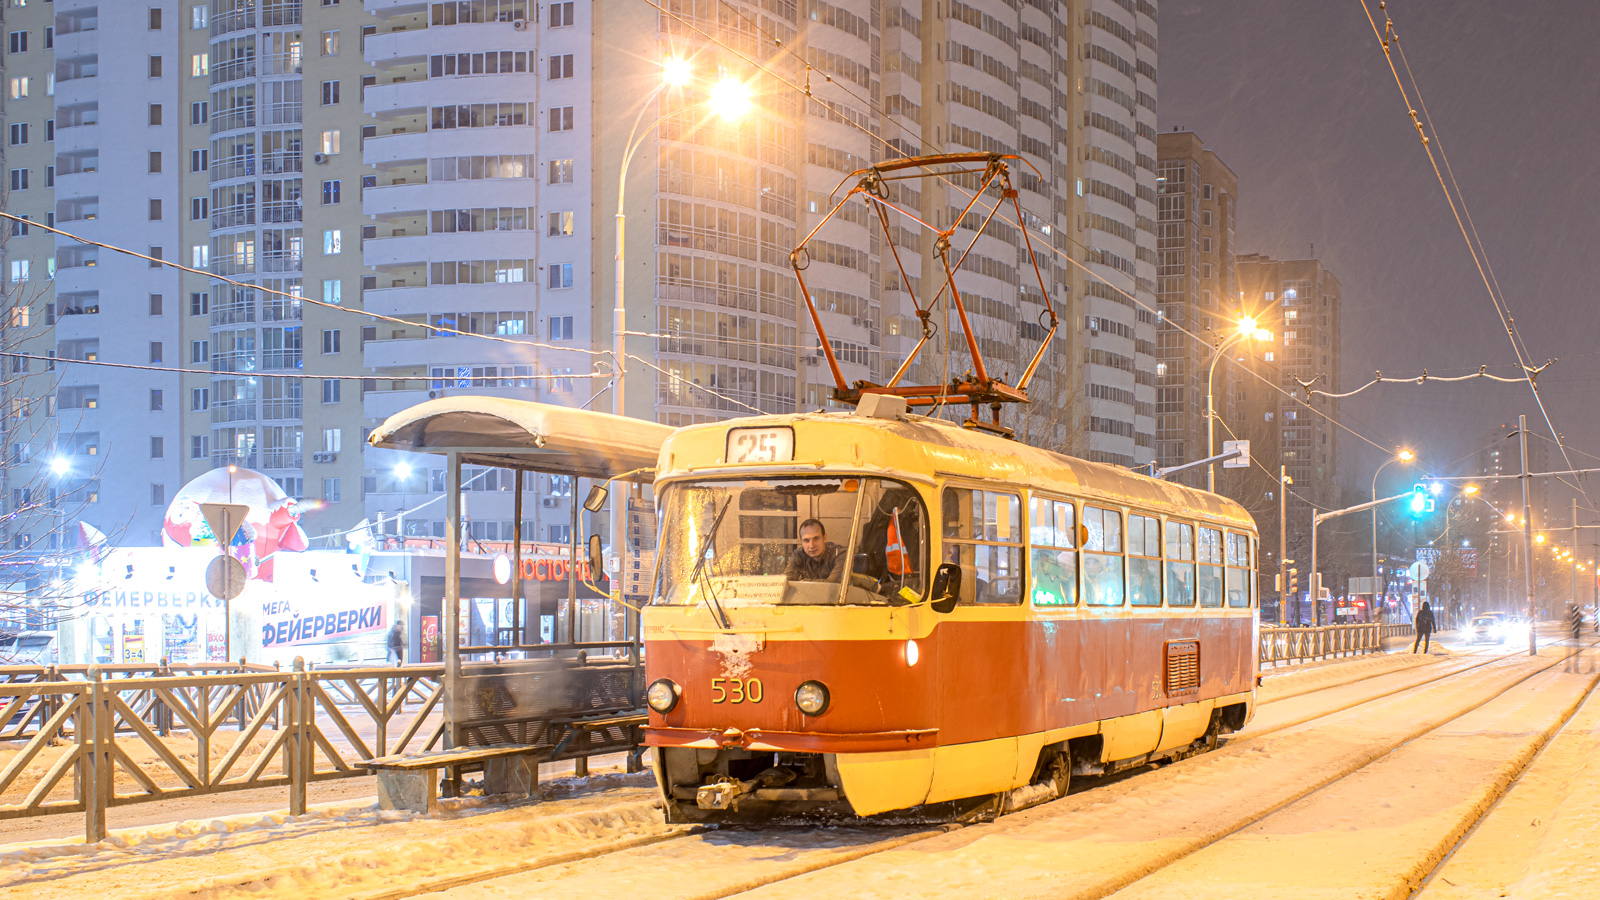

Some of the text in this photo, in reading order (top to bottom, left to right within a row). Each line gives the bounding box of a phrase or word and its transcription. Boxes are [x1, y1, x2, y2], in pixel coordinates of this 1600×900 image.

[738, 433, 777, 463] 25
[518, 557, 609, 581] ОСТОЧНА
[262, 600, 291, 616] МЕГА
[207, 633, 226, 643] ВХО
[262, 605, 382, 648] ФЕЙЕРВЕРКИ
[711, 677, 764, 704] 530
